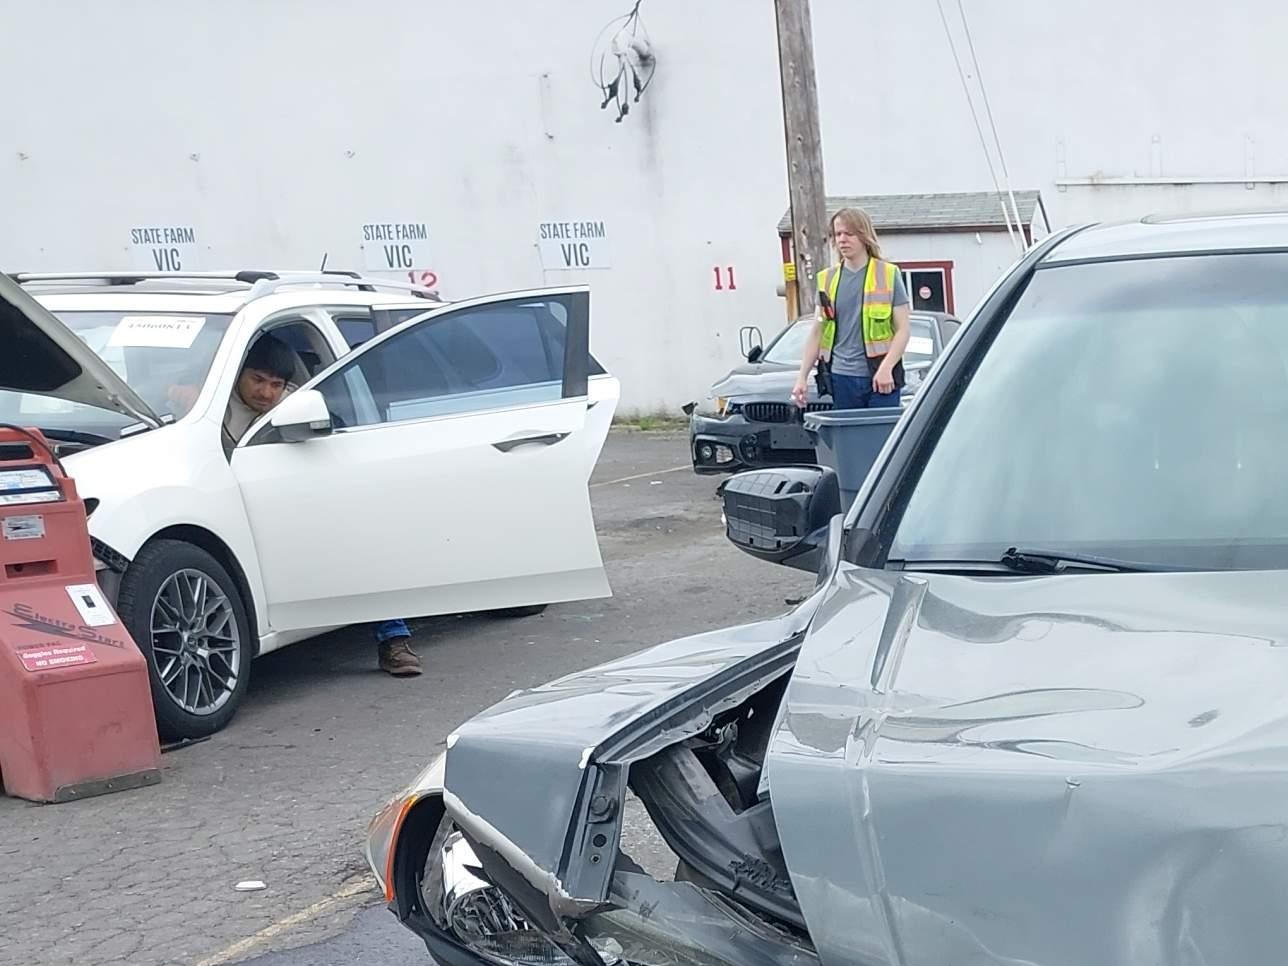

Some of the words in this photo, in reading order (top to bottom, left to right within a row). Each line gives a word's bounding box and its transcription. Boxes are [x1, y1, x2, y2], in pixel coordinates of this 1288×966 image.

[131, 227, 163, 244] STATE
[163, 227, 195, 244] FARM
[363, 224, 394, 241] STATE
[395, 223, 427, 240] FARM
[540, 222, 571, 239] STATE
[573, 221, 606, 239] FARM
[152, 247, 181, 272] VIC
[384, 244, 413, 268] VIC
[561, 242, 590, 267] VIC
[714, 266, 736, 290] 11
